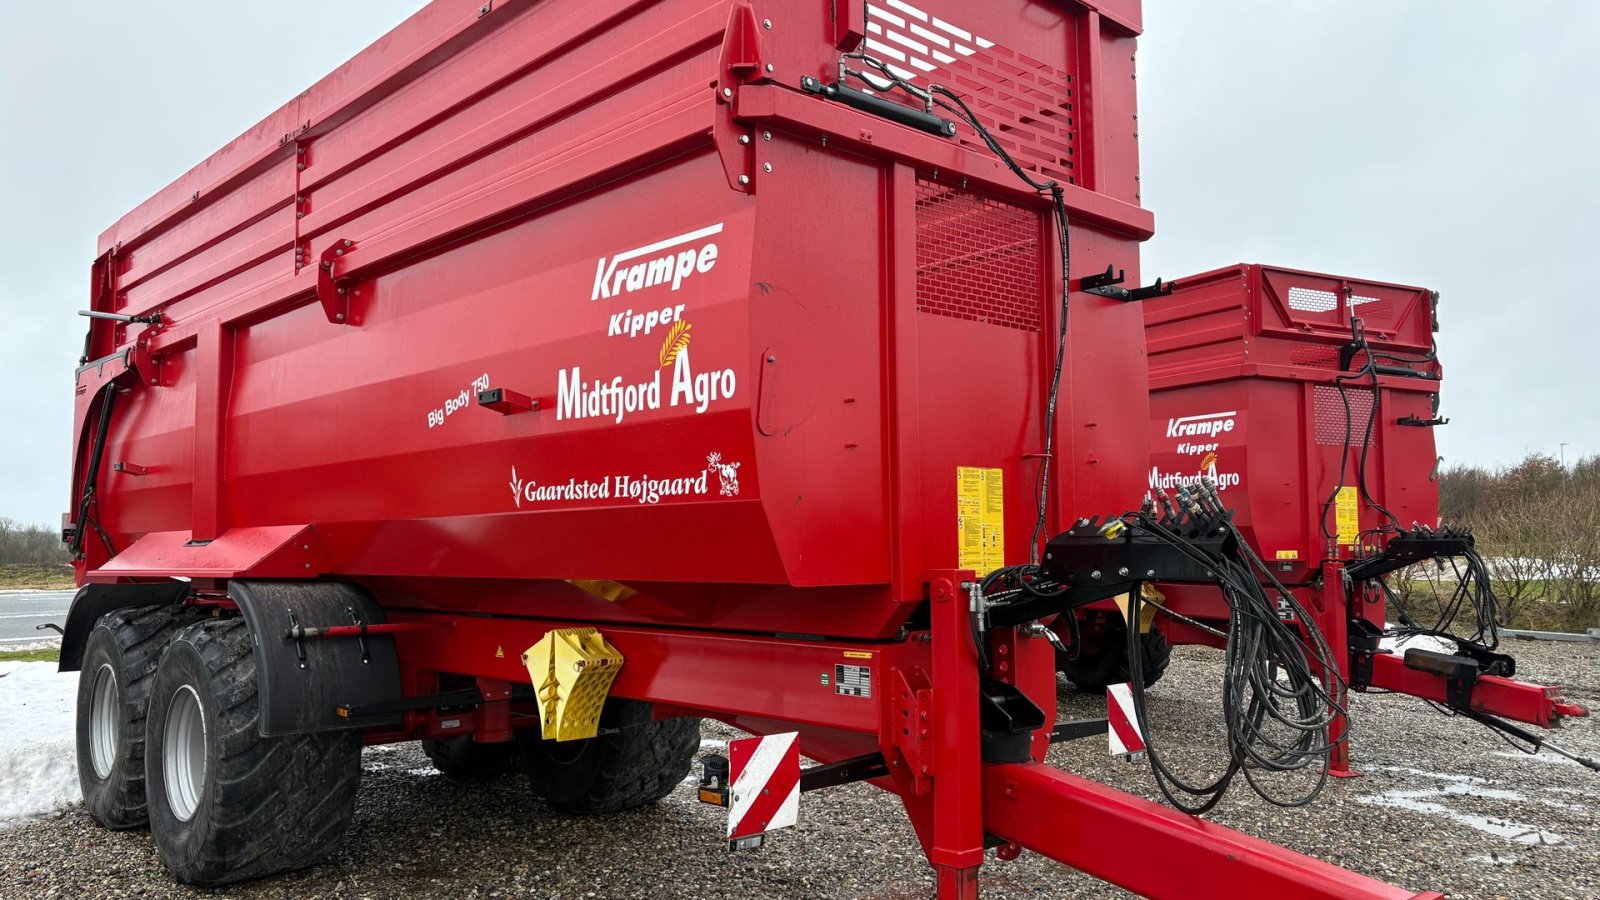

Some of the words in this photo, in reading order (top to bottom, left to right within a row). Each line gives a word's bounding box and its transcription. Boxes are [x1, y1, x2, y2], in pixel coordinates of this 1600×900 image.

[591, 223, 724, 300] Krampe
[608, 304, 686, 337] Kipper
[428, 409, 444, 428] Big
[445, 390, 470, 416] Body
[471, 373, 490, 397] 750
[556, 366, 660, 424] Midtfjord
[670, 345, 736, 414] Agro
[1166, 411, 1237, 438] Krampe
[1177, 443, 1219, 456] Kipper
[524, 476, 609, 502] Gaardsted
[614, 470, 708, 504] Højgaard
